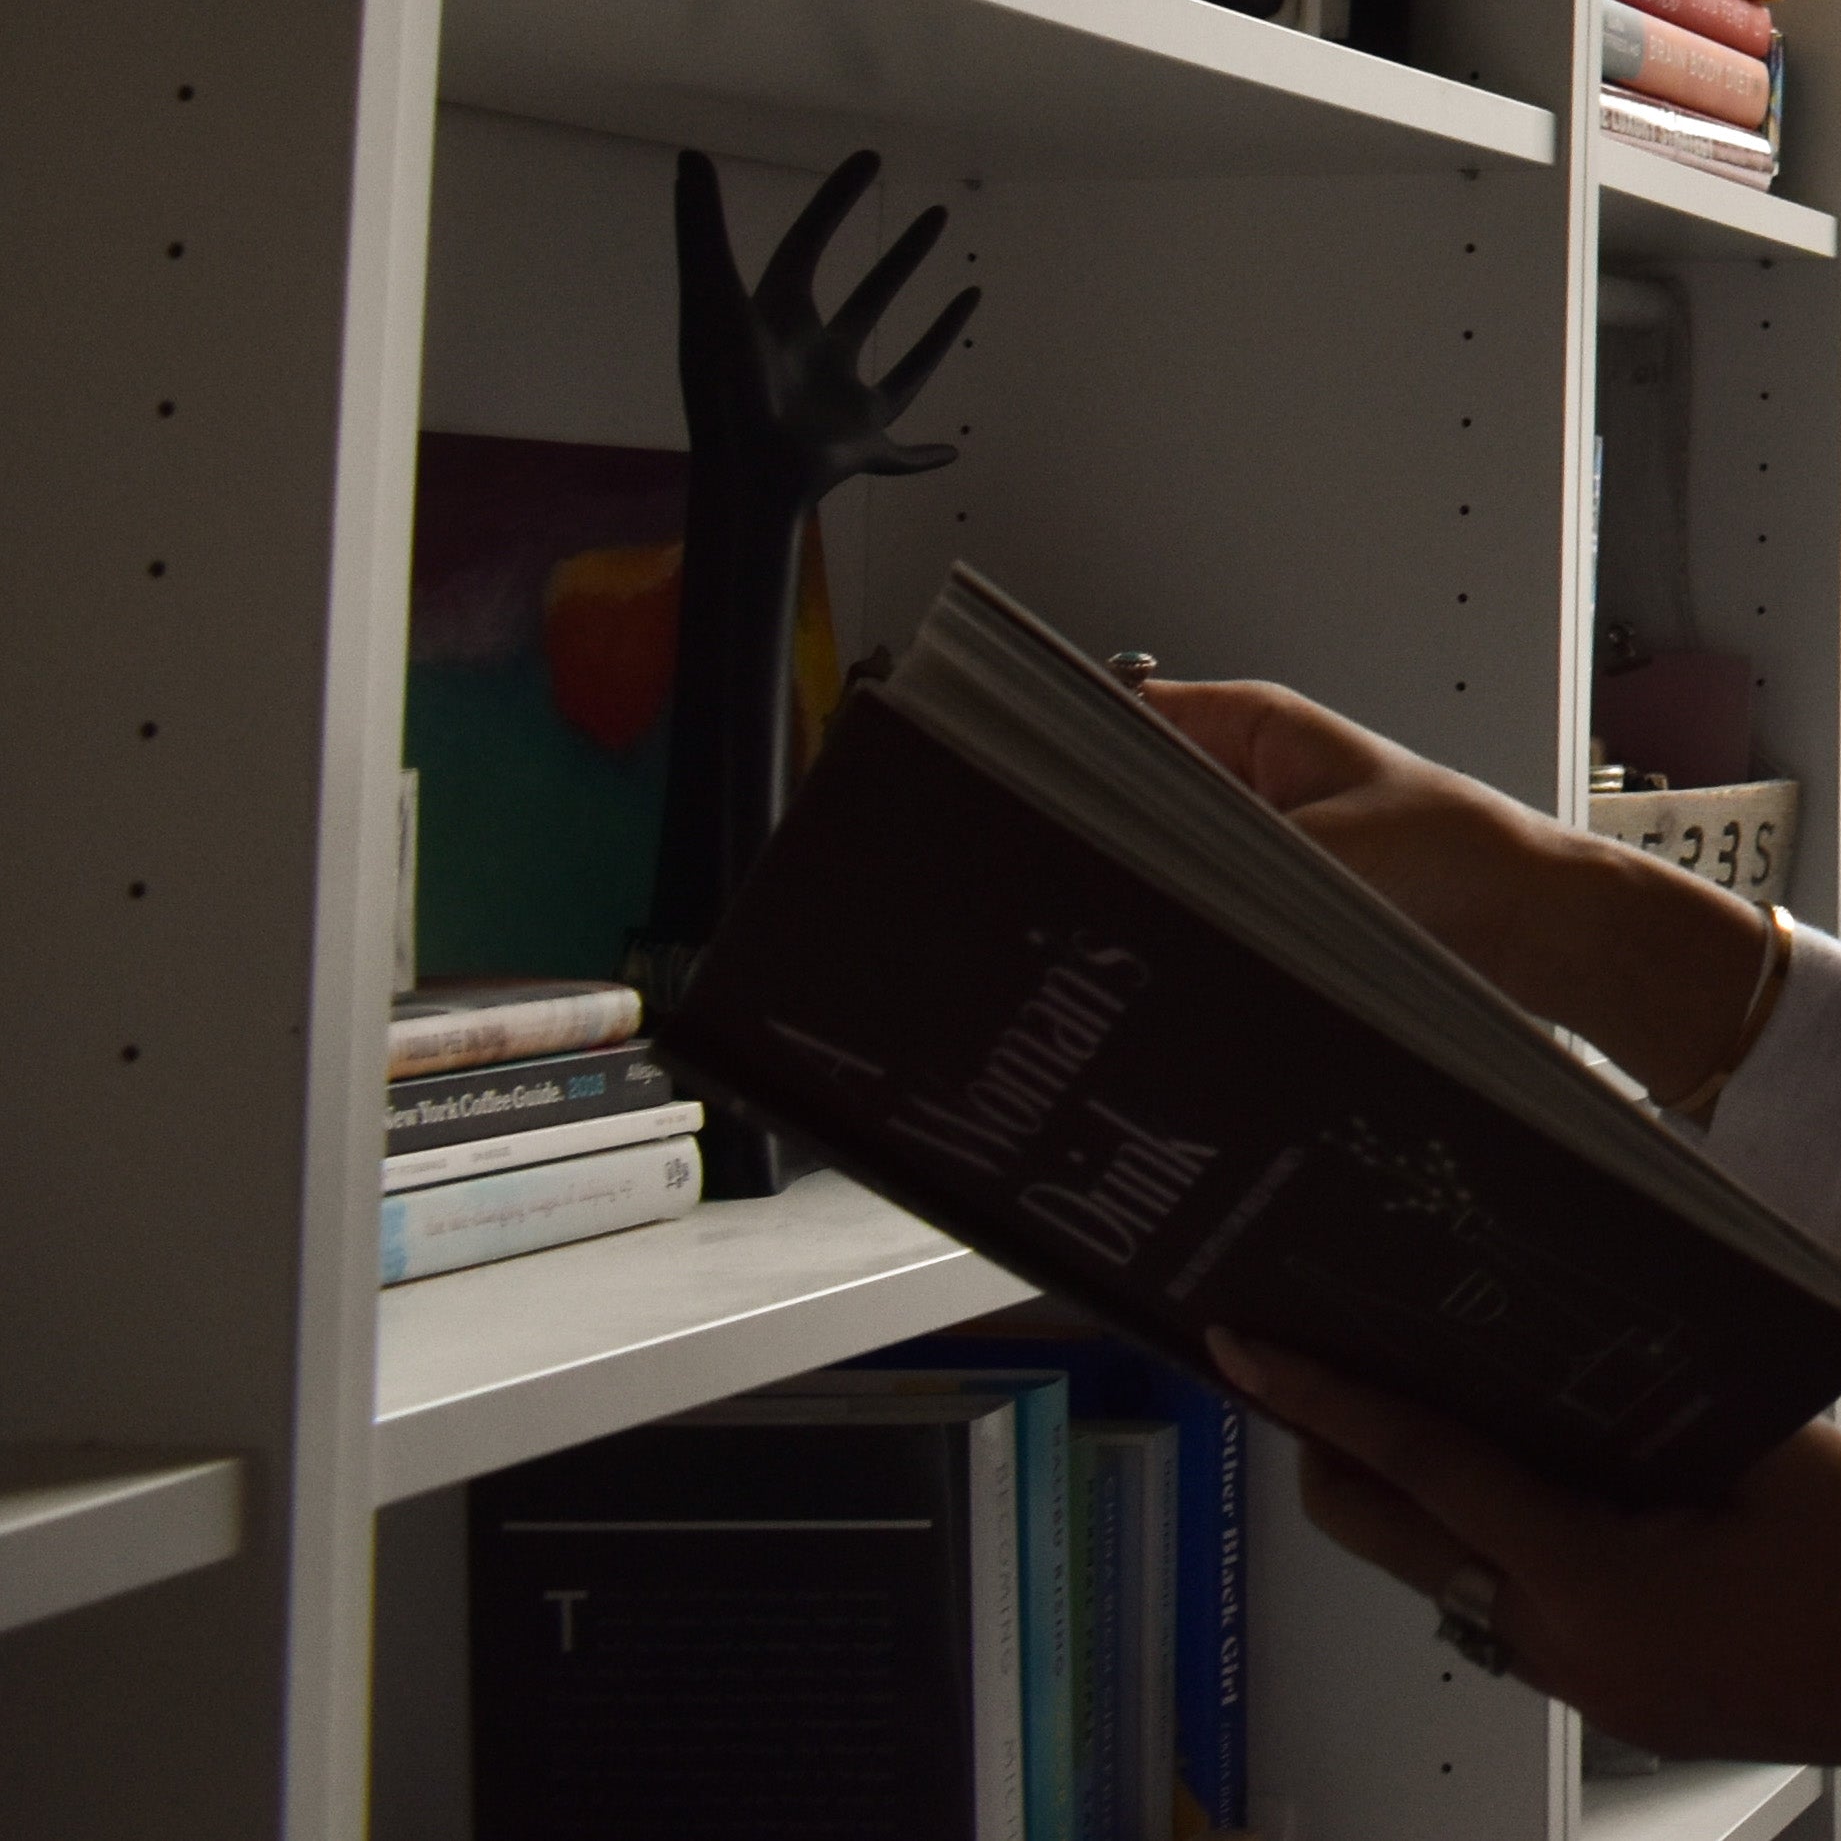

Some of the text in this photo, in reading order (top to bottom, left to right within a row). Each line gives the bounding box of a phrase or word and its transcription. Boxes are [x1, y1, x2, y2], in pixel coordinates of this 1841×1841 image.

[418, 1098, 461, 1125] York
[459, 1086, 512, 1119] Coffee
[886, 927, 1150, 1179] Woman's
[1017, 1097, 1221, 1266] Drink
[1052, 1422, 1065, 1548] MALIBU
[1221, 1414, 1240, 1518] Other
[994, 1461, 1014, 1678] BECOMING
[1052, 1563, 1066, 1678] RISING
[1220, 1526, 1239, 1629] Black
[1220, 1635, 1240, 1707] Girl
